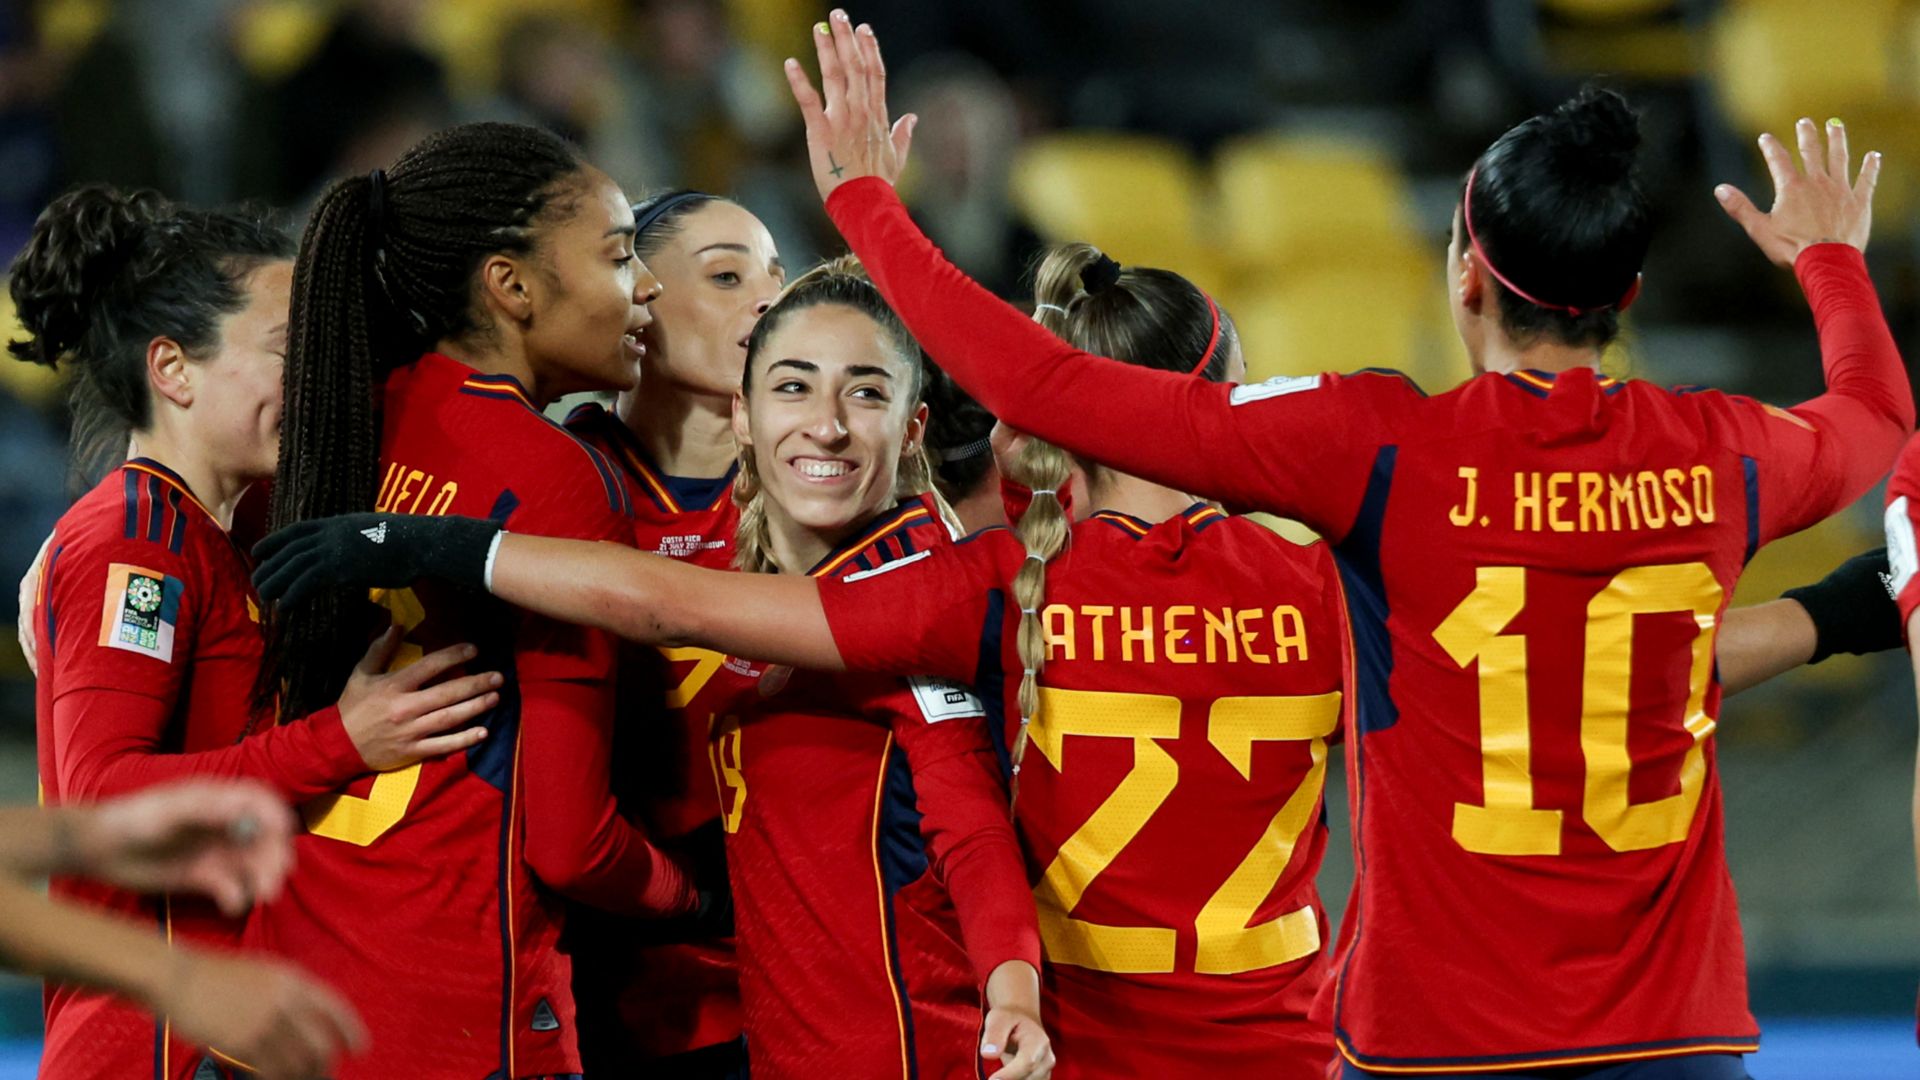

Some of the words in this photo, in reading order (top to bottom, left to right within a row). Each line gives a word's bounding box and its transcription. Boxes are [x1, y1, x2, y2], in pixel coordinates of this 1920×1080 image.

[1449, 466, 1490, 527] J.
[1514, 465, 1715, 533] HERMOSO
[661, 536, 683, 544] COSTA
[684, 534, 701, 542] RICA
[1041, 604, 1309, 664] ATHENEA
[946, 694, 964, 703] FIFA
[1431, 562, 1723, 856] 10
[1027, 686, 1343, 975] 22
